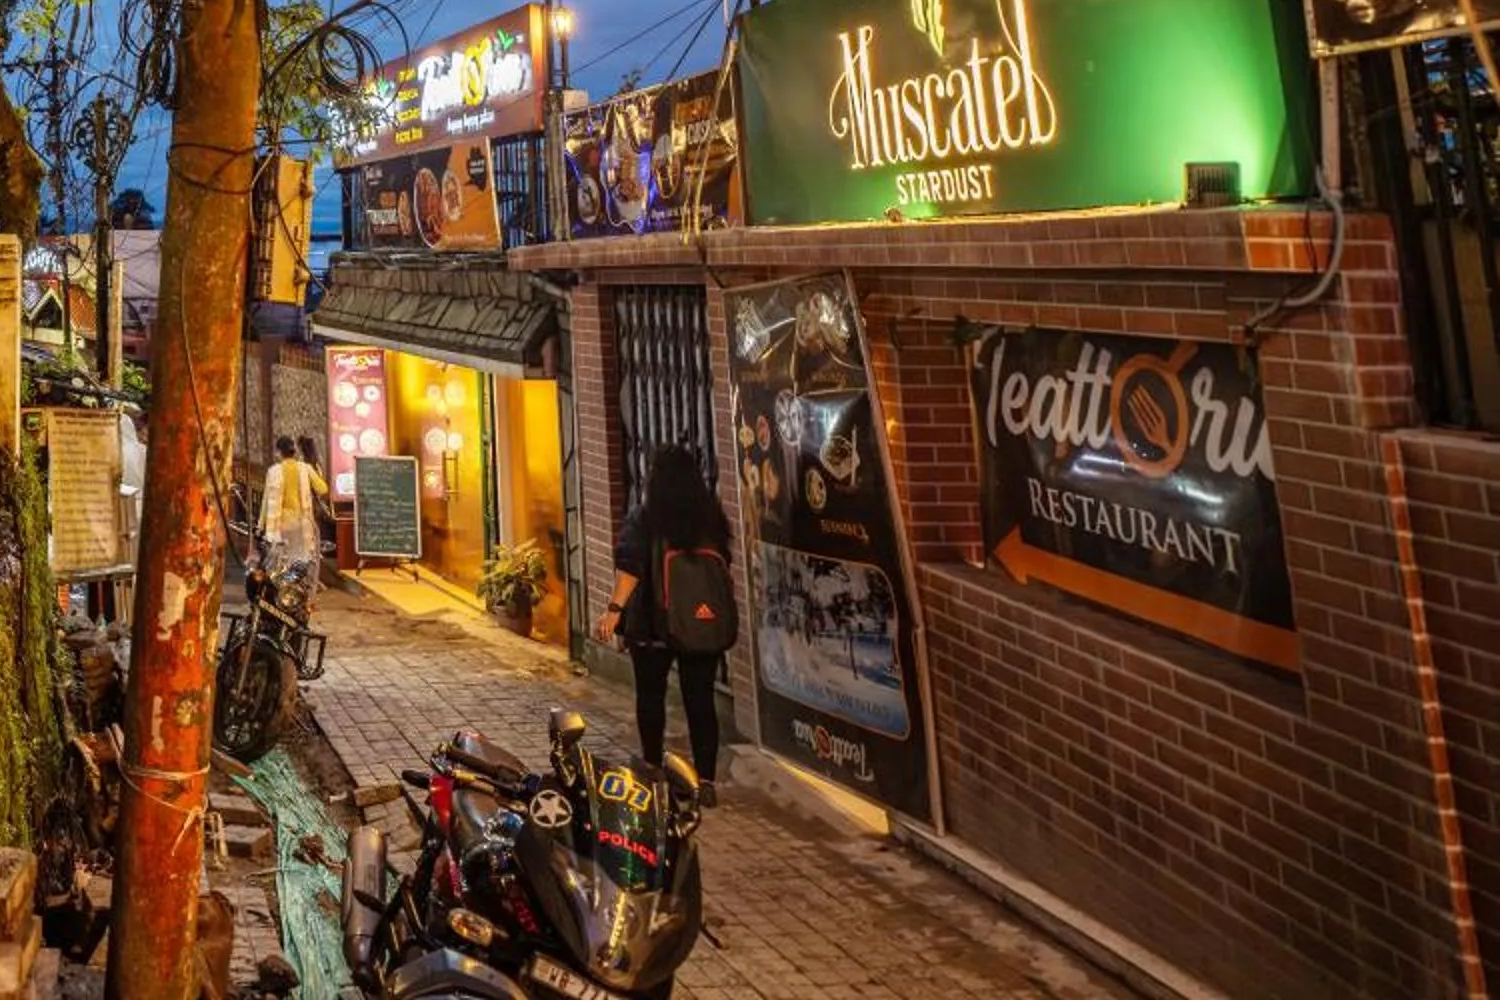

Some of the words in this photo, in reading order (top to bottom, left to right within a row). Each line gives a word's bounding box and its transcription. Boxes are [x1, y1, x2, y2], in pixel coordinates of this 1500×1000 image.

[895, 164, 993, 206] STARDUST
[1027, 476, 1241, 574] RESTAURANT
[597, 829, 660, 869] POLICE
